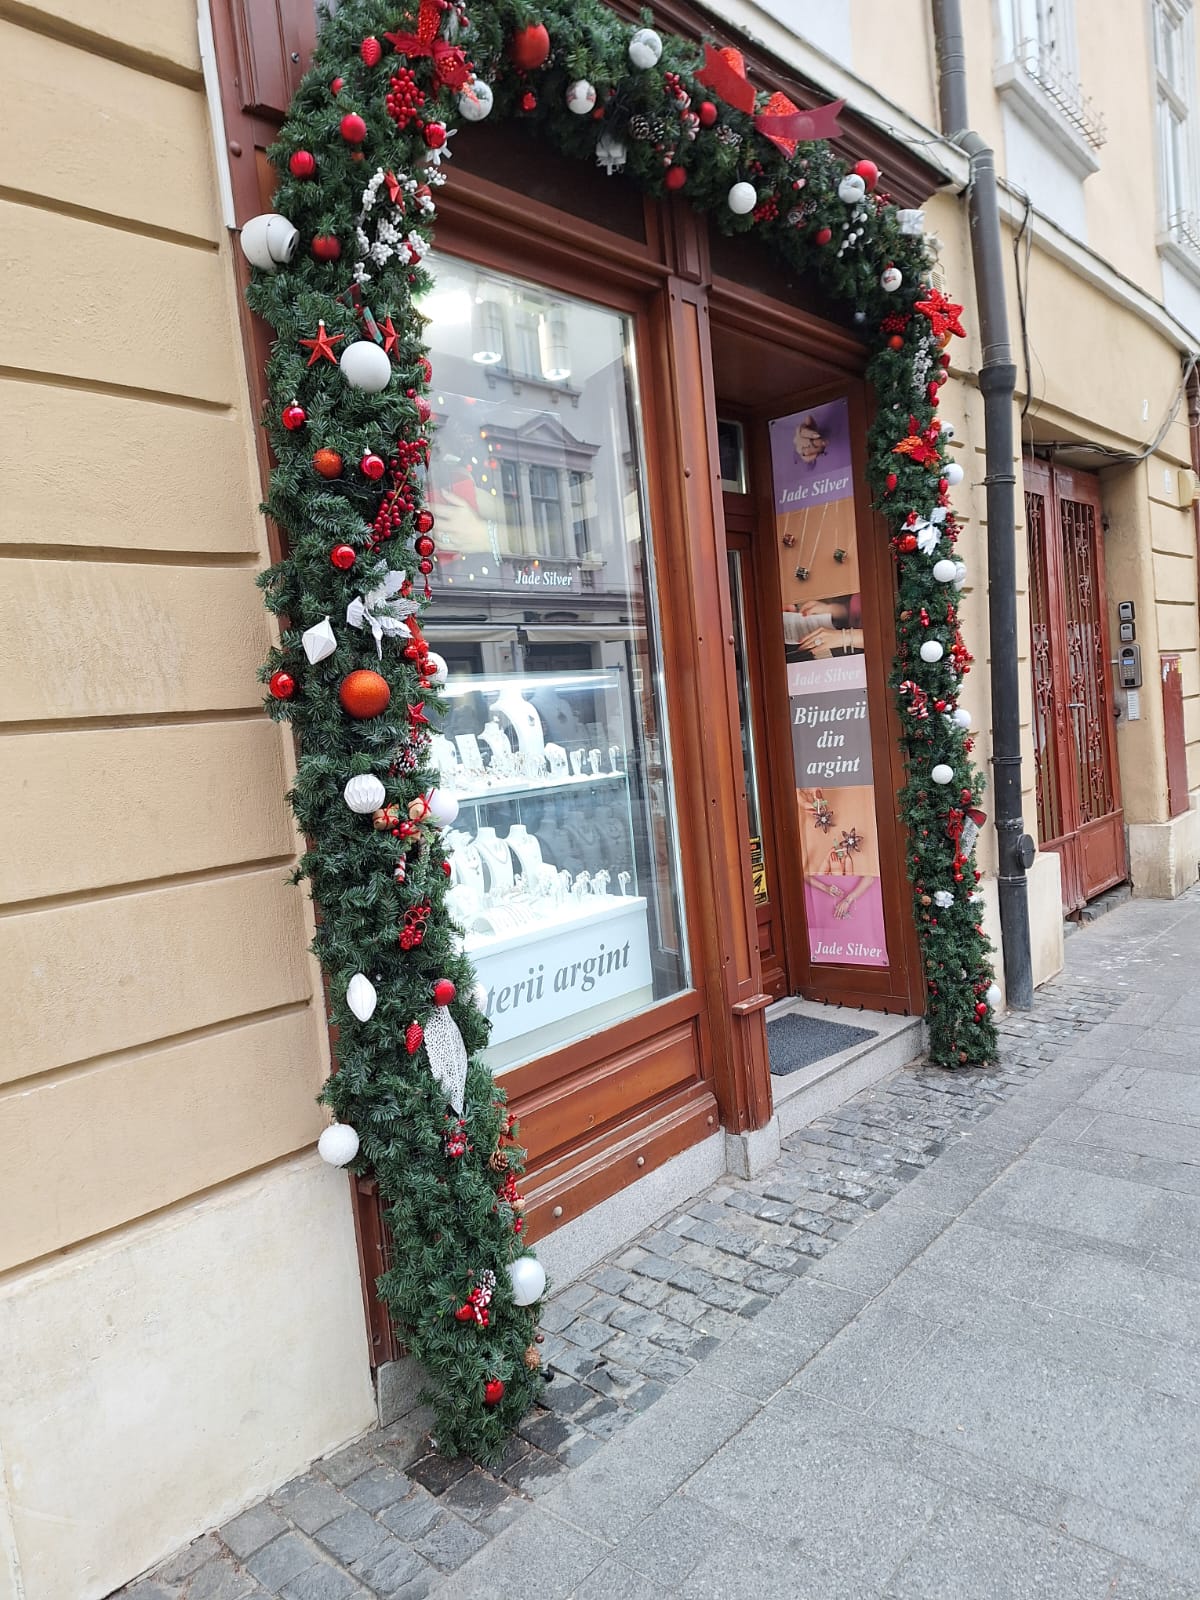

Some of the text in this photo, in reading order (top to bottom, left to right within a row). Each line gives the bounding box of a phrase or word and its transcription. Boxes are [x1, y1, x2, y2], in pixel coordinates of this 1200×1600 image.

[779, 476, 849, 504] Jade Silver
[515, 570, 573, 586] Jade Silver
[793, 667, 861, 687] Jade Silver
[793, 701, 867, 728] Bijuterii
[816, 731, 844, 749] din
[806, 755, 861, 778] argint
[815, 942, 882, 957] Jade Silver
[485, 940, 630, 1018] terii argint
